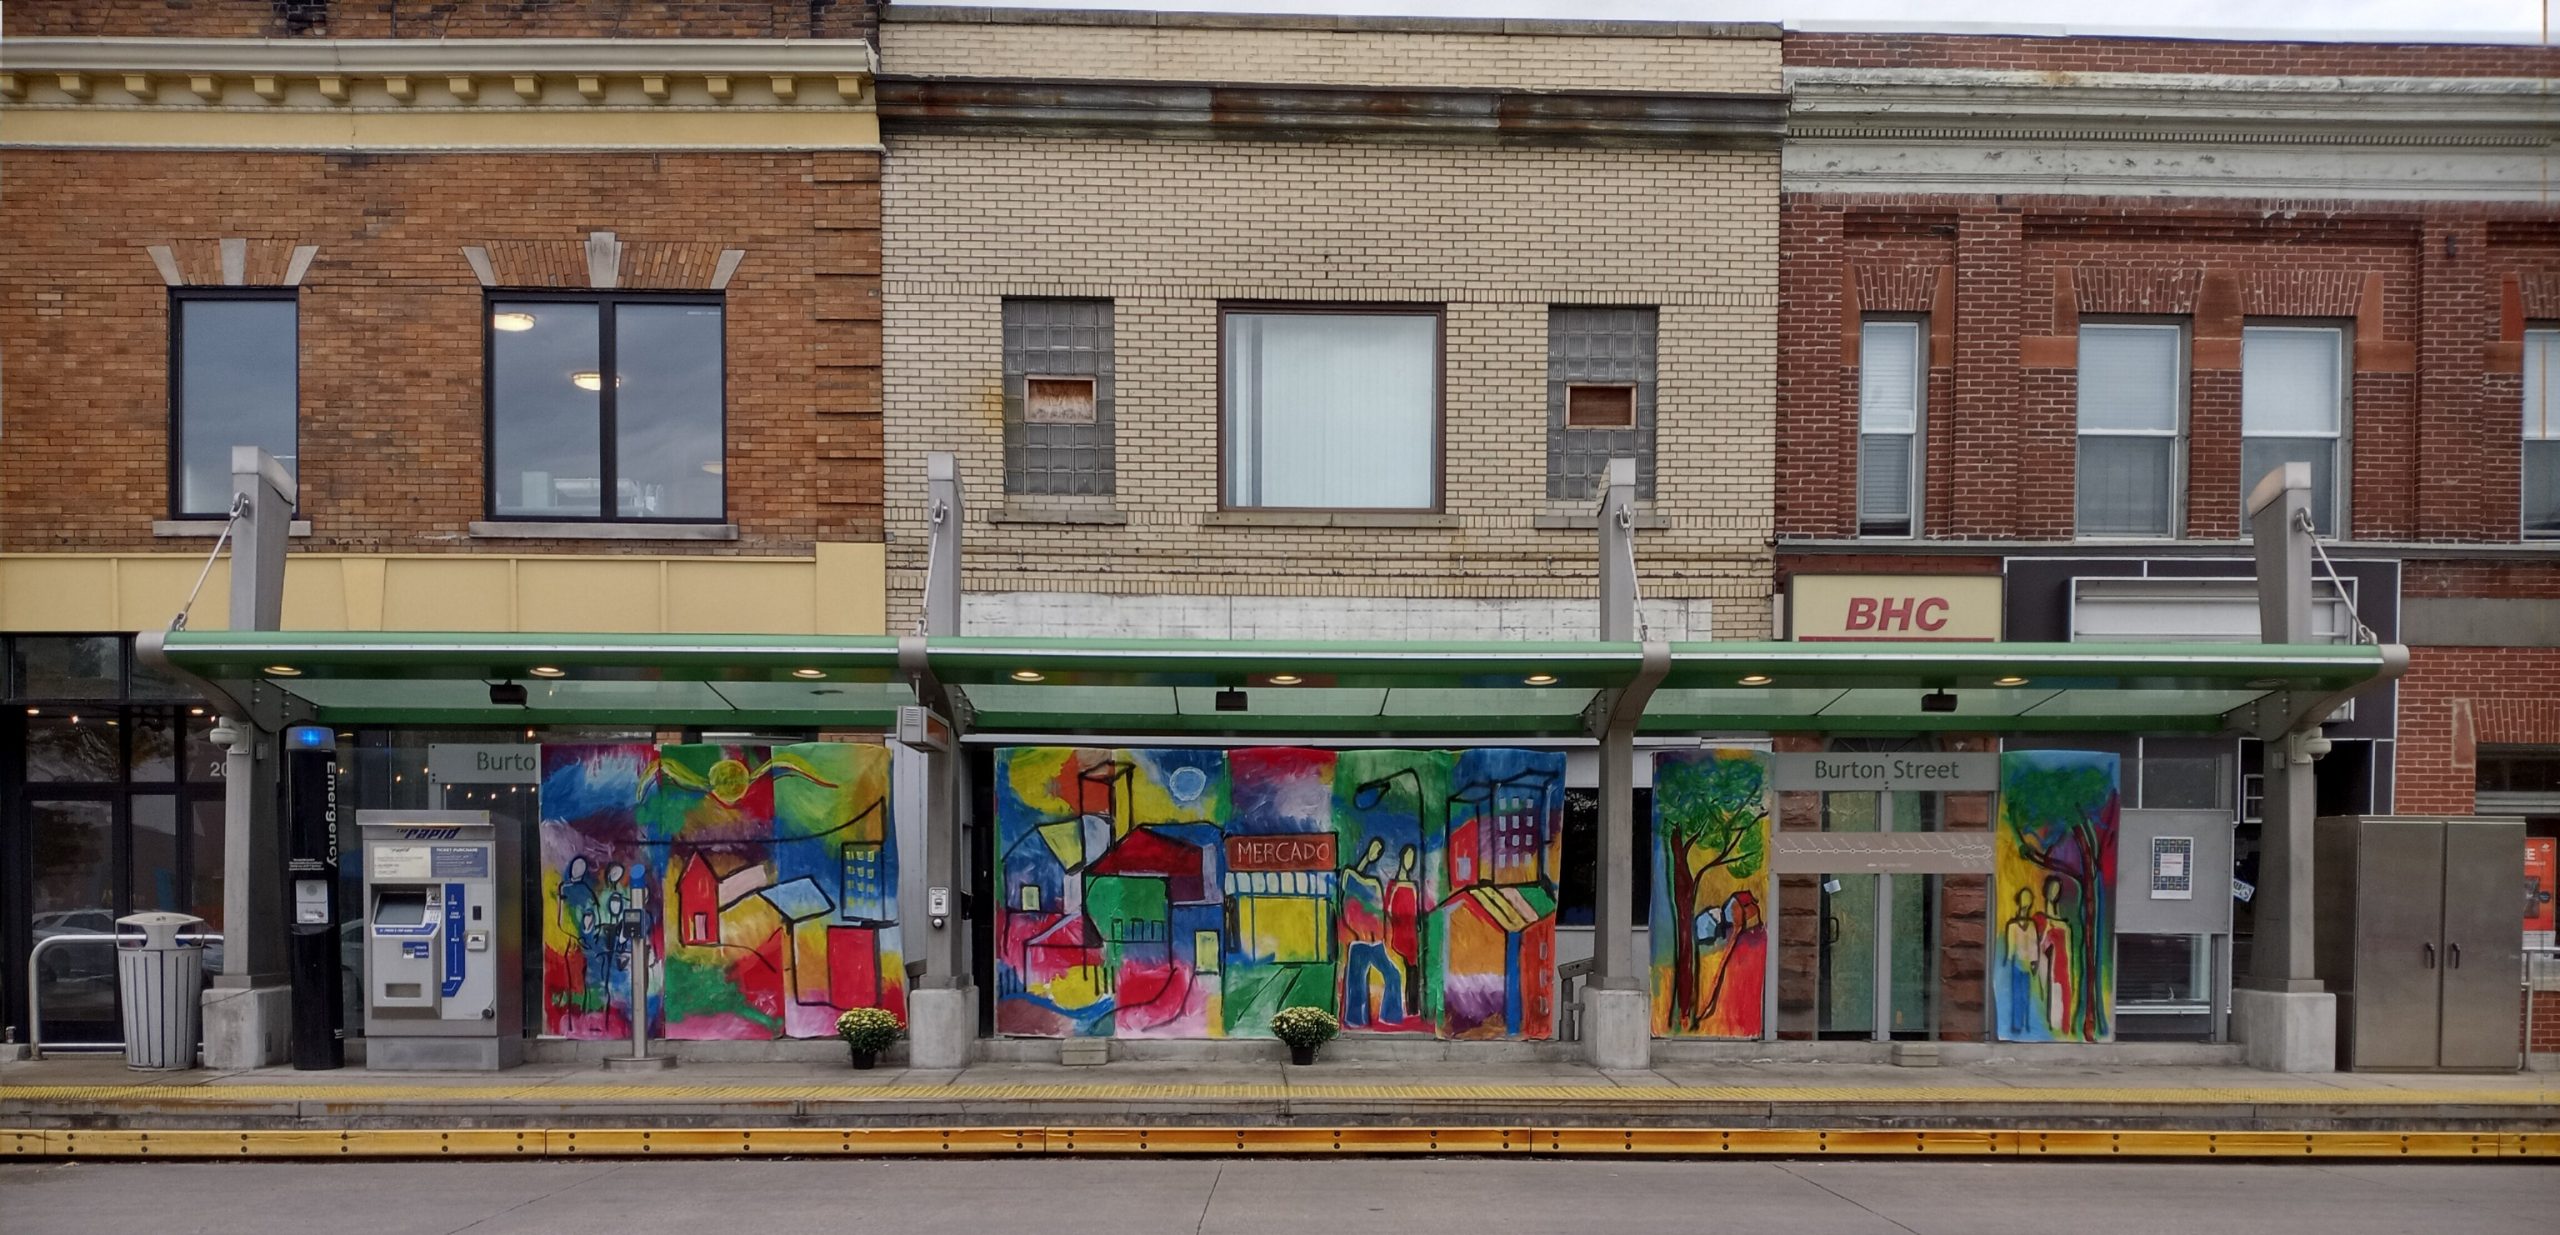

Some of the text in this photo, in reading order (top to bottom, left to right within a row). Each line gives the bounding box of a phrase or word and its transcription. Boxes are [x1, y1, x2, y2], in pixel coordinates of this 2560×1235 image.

[1846, 597, 1949, 631] BHC
[476, 752, 536, 771] Burto
[1815, 760, 1959, 779] Burton Street
[325, 761, 337, 867] Emergency
[1238, 842, 1330, 864] MERCADO
